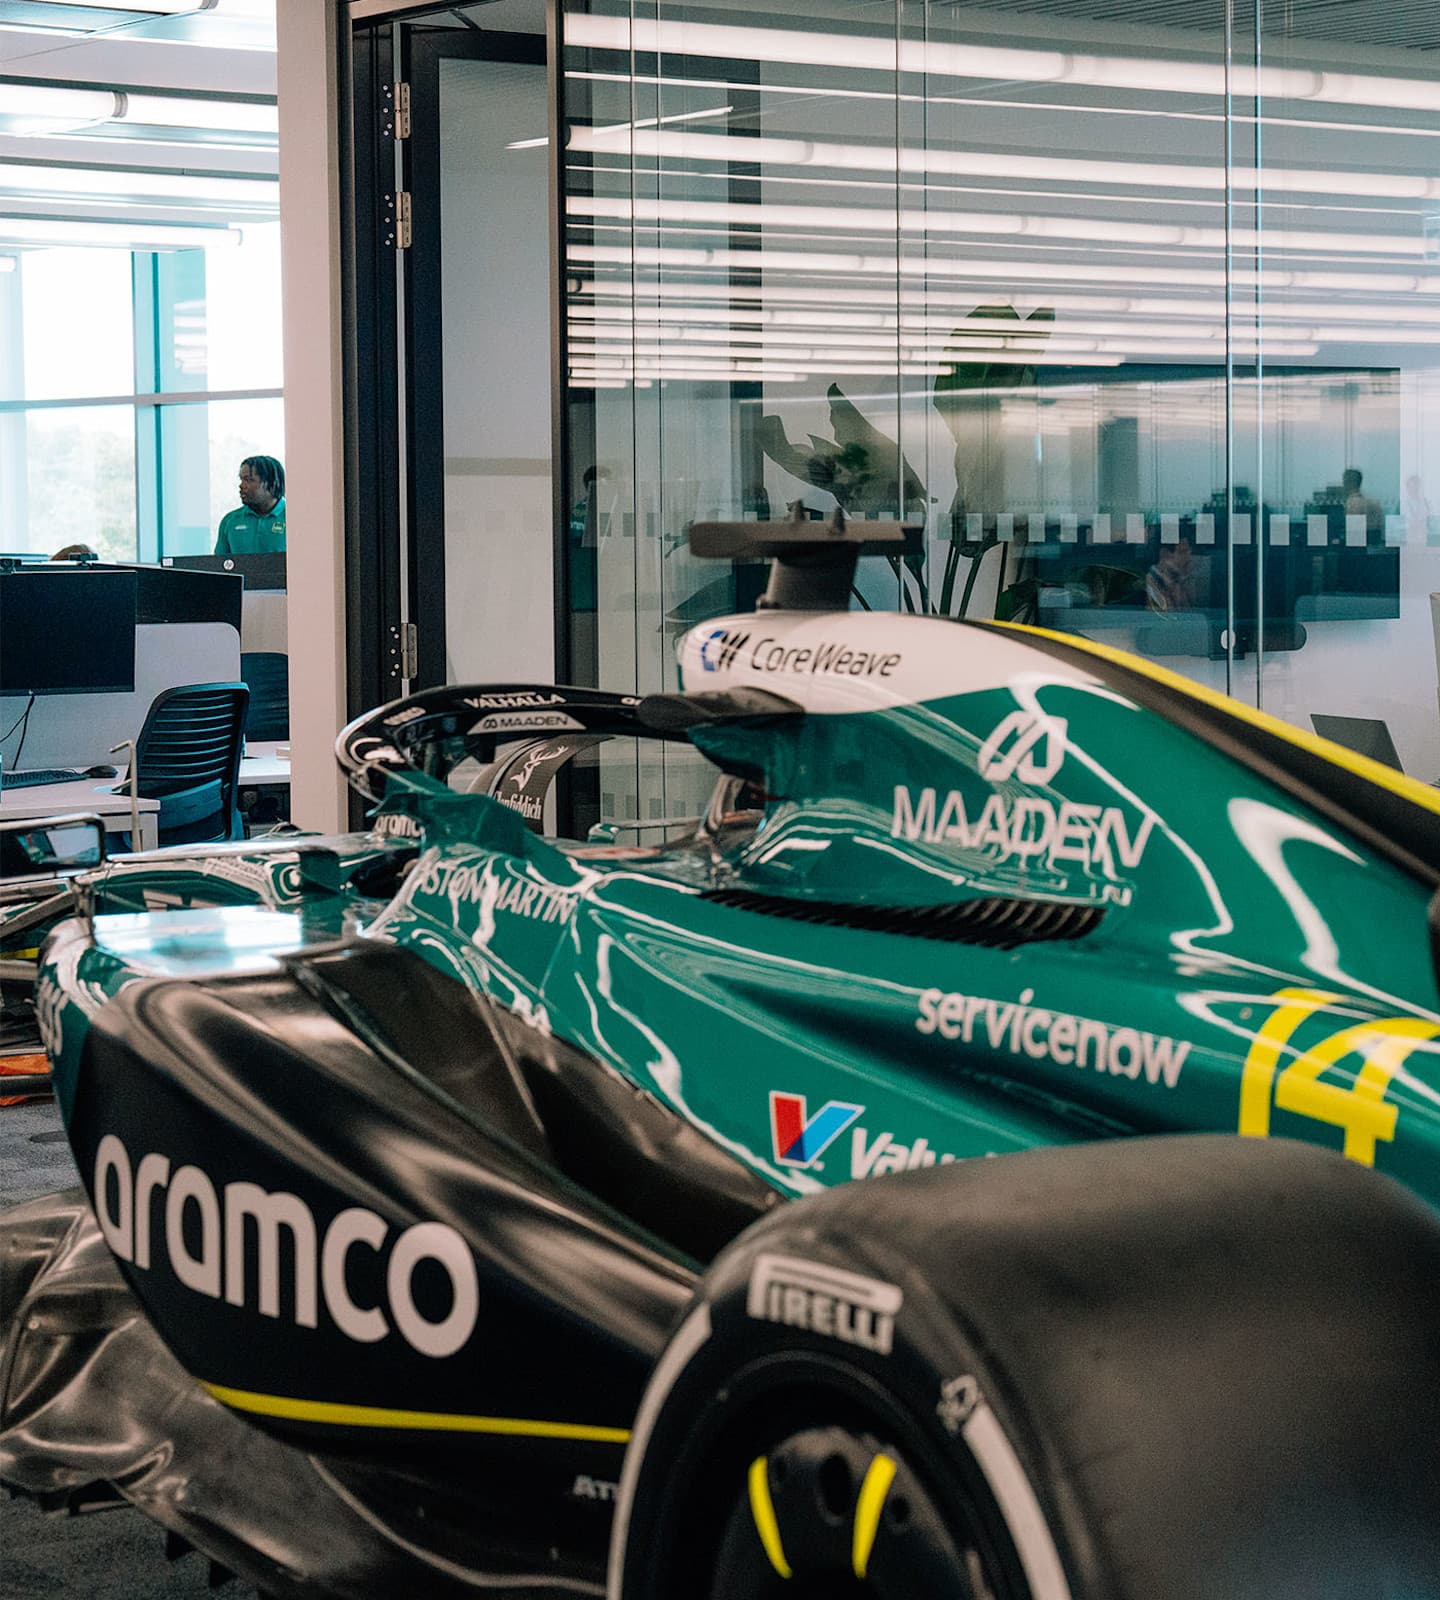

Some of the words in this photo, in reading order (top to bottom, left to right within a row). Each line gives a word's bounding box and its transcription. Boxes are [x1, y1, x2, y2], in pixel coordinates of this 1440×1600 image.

[751, 638, 901, 676] CoreWeave
[464, 692, 567, 708] VALHALLA
[501, 715, 568, 727] MAADEN
[891, 785, 1156, 868] MAADEN
[915, 988, 1192, 1088] servicenow
[94, 1134, 480, 1358] aramco
[746, 1253, 903, 1357] PIRELLI
